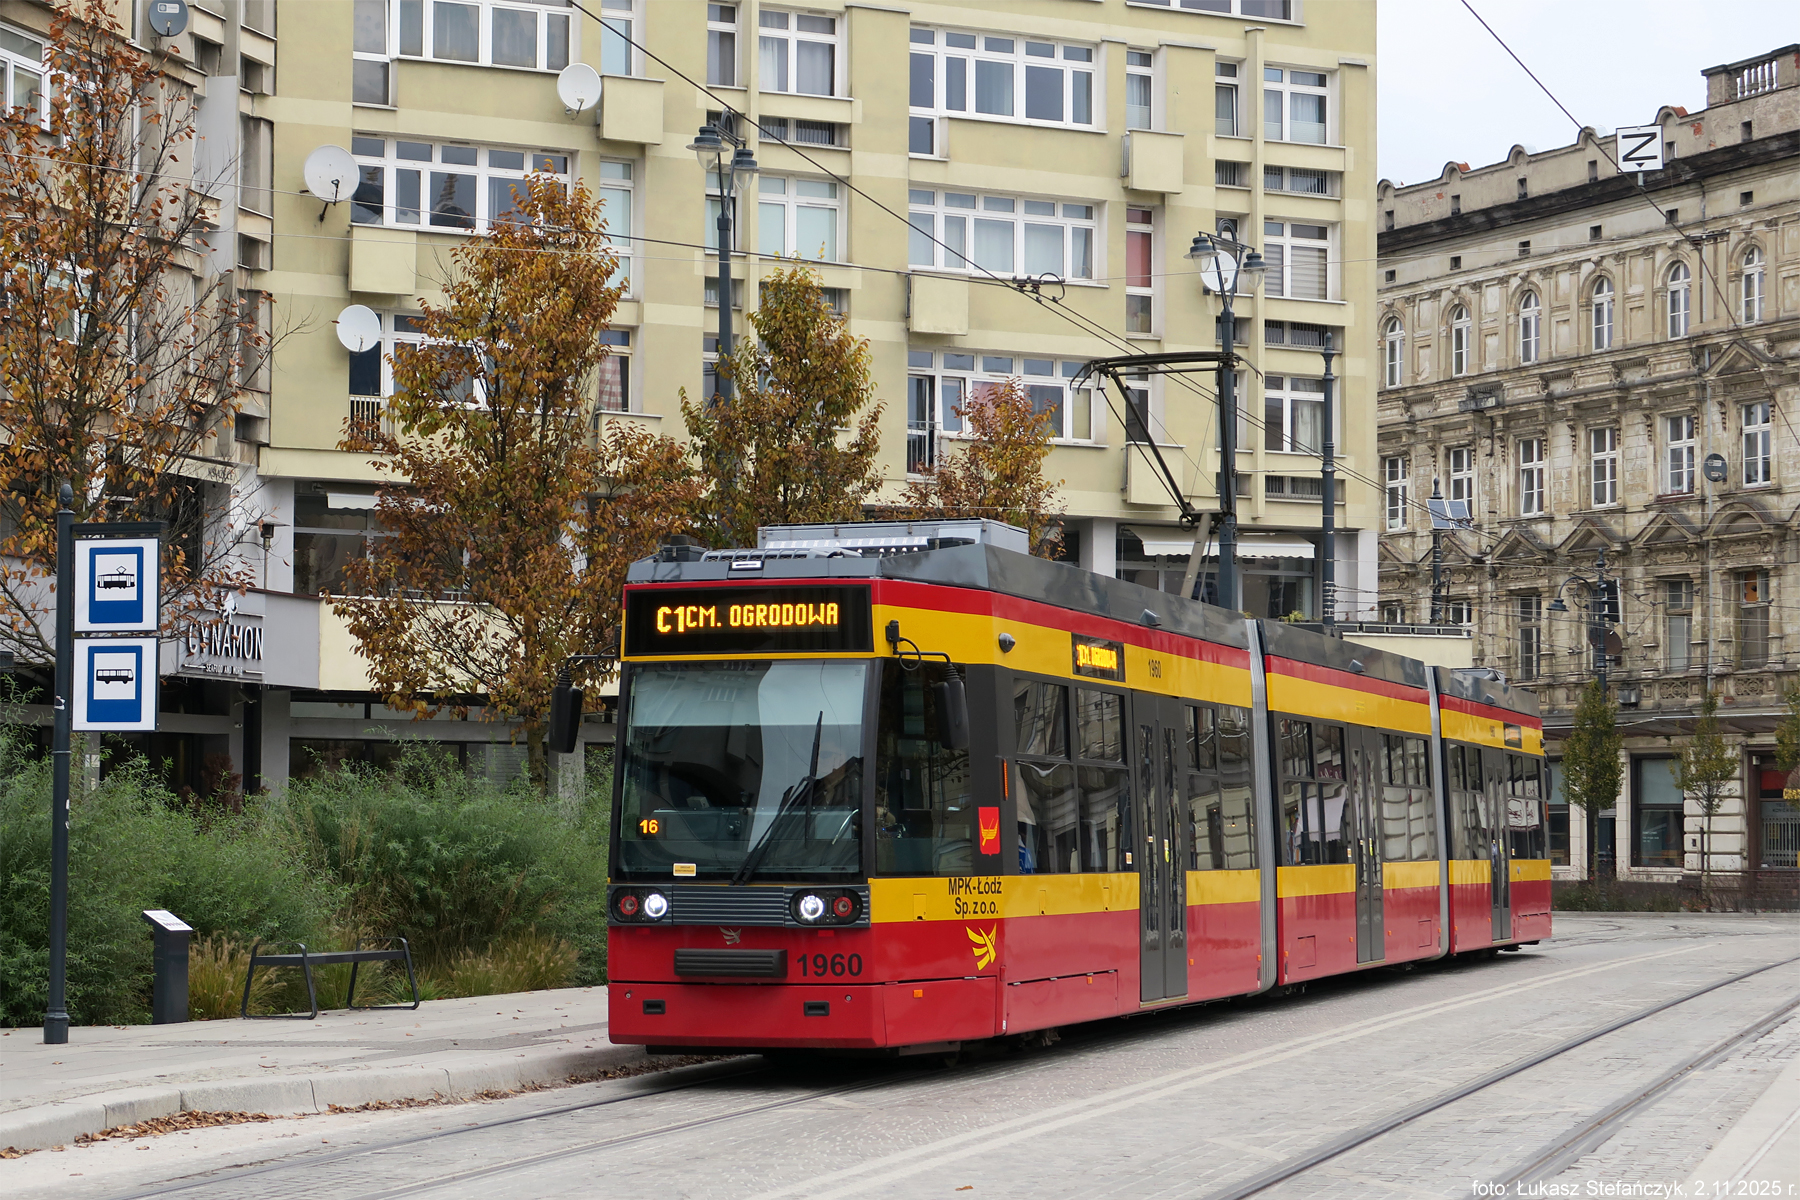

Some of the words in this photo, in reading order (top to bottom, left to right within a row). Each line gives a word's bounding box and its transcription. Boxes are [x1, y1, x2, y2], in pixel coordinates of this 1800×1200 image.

[1621, 132, 1658, 162] Z
[656, 606, 685, 633] C1
[686, 605, 722, 628] CM.
[729, 602, 839, 627] OGRODOWA
[188, 621, 264, 660] CYNAMON
[1148, 658, 1162, 679] 1960
[639, 819, 659, 834] 16
[948, 876, 1002, 896] MPK-Łódź
[954, 896, 971, 919] Sp.
[980, 901, 999, 915] o.o.
[797, 953, 863, 977] 1960
